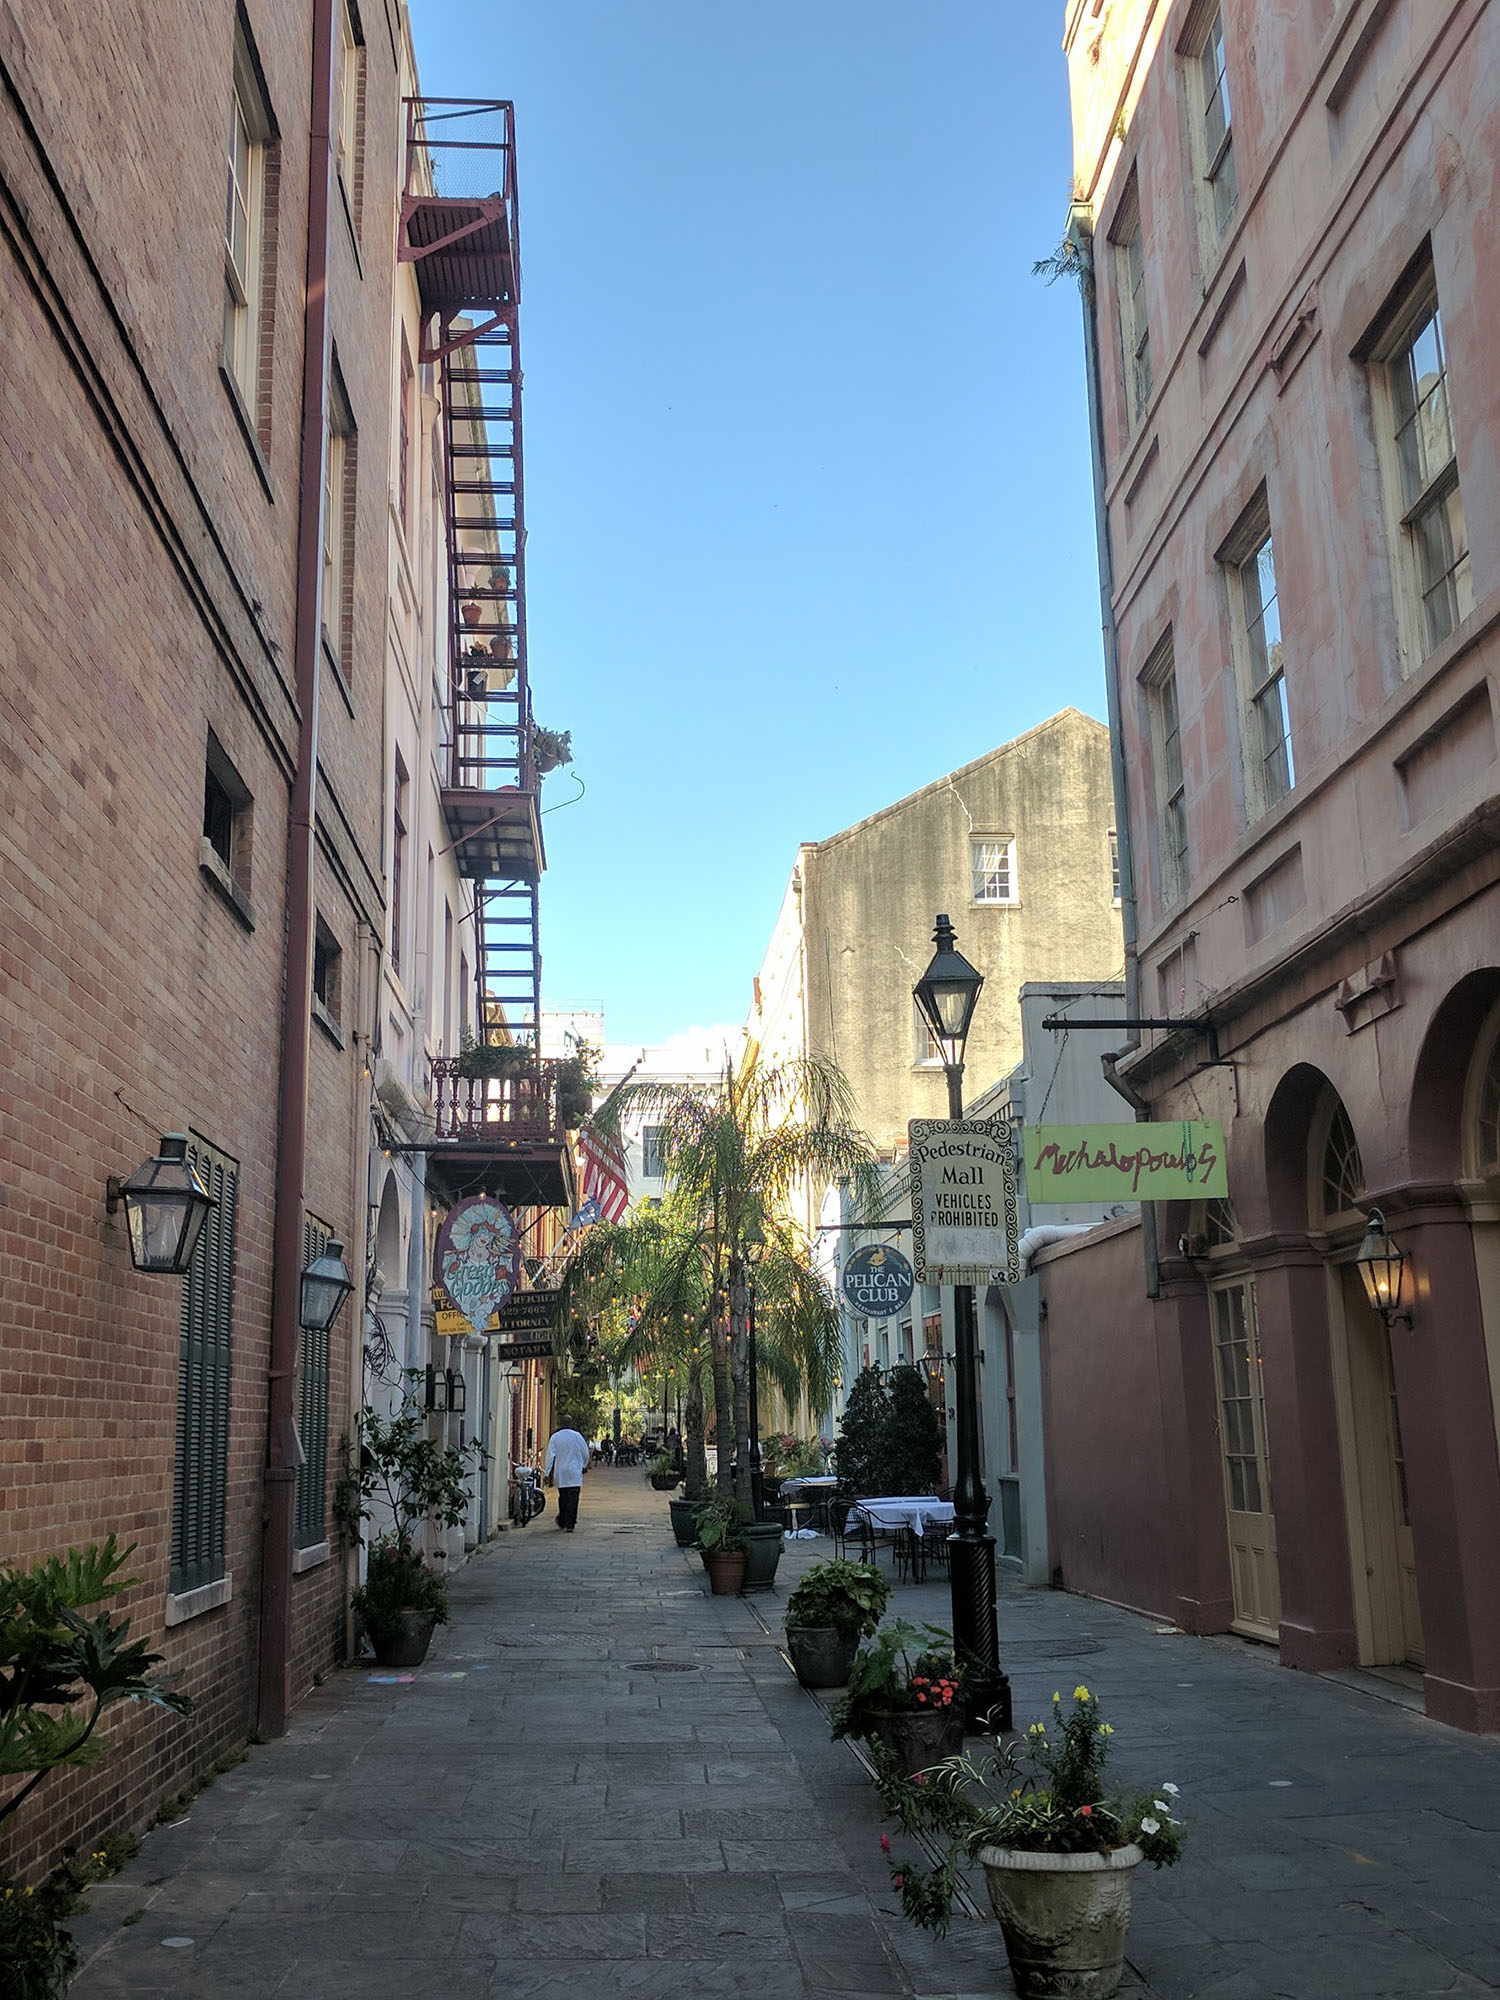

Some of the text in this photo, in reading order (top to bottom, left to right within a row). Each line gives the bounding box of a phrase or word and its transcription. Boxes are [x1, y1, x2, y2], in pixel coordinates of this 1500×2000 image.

[918, 1140, 1005, 1166] Pedestrian
[940, 1165, 985, 1185] Mall
[935, 1193, 992, 1210] VEHICLES
[930, 1210, 999, 1227] PROHIBITED
[845, 1272, 912, 1289] PELICAN
[856, 1287, 899, 1303] CLUB
